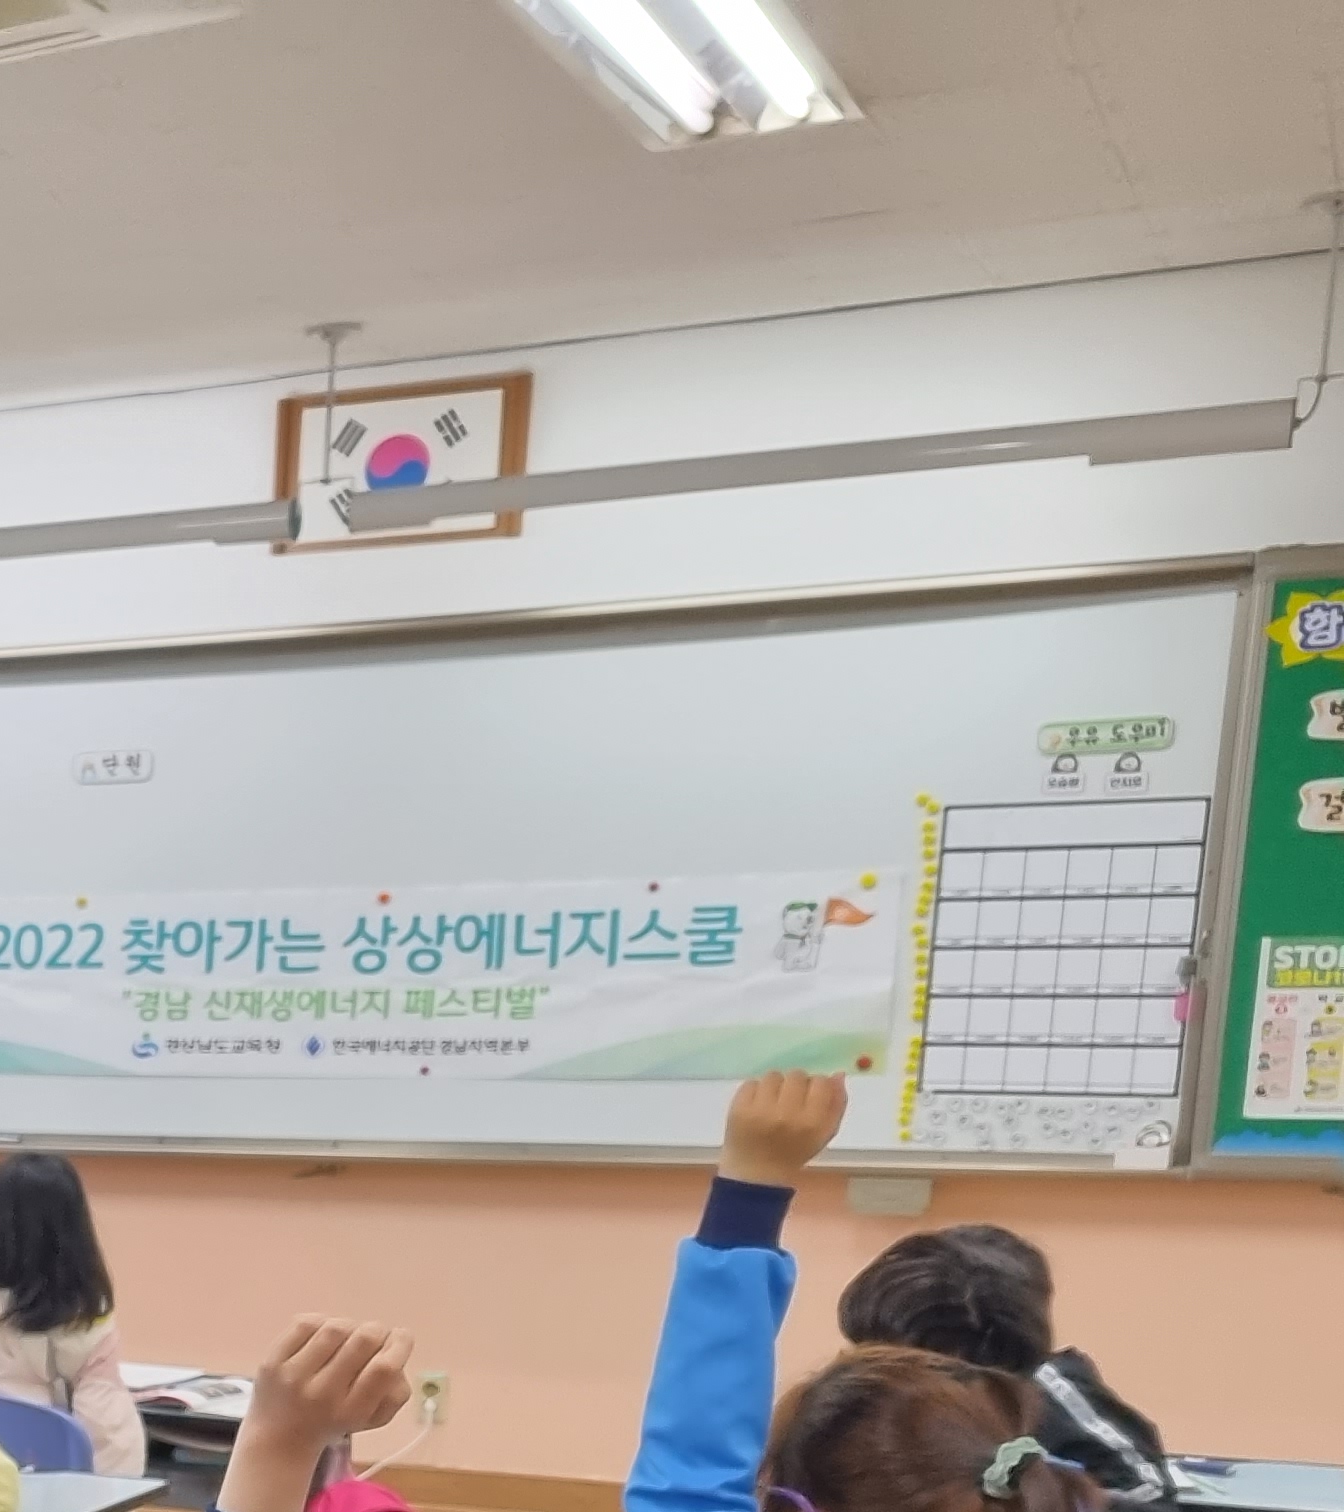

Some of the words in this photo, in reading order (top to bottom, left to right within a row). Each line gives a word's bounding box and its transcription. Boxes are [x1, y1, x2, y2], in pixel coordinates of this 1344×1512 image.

[121, 917, 326, 975] 찾아가는
[342, 905, 744, 976] 상상에너지스쿨
[1274, 945, 1344, 970] STO
[203, 988, 391, 1022] 신재생에너지
[332, 1037, 436, 1055] 한국에너지공단
[441, 1037, 530, 1055] 경남지역본부
